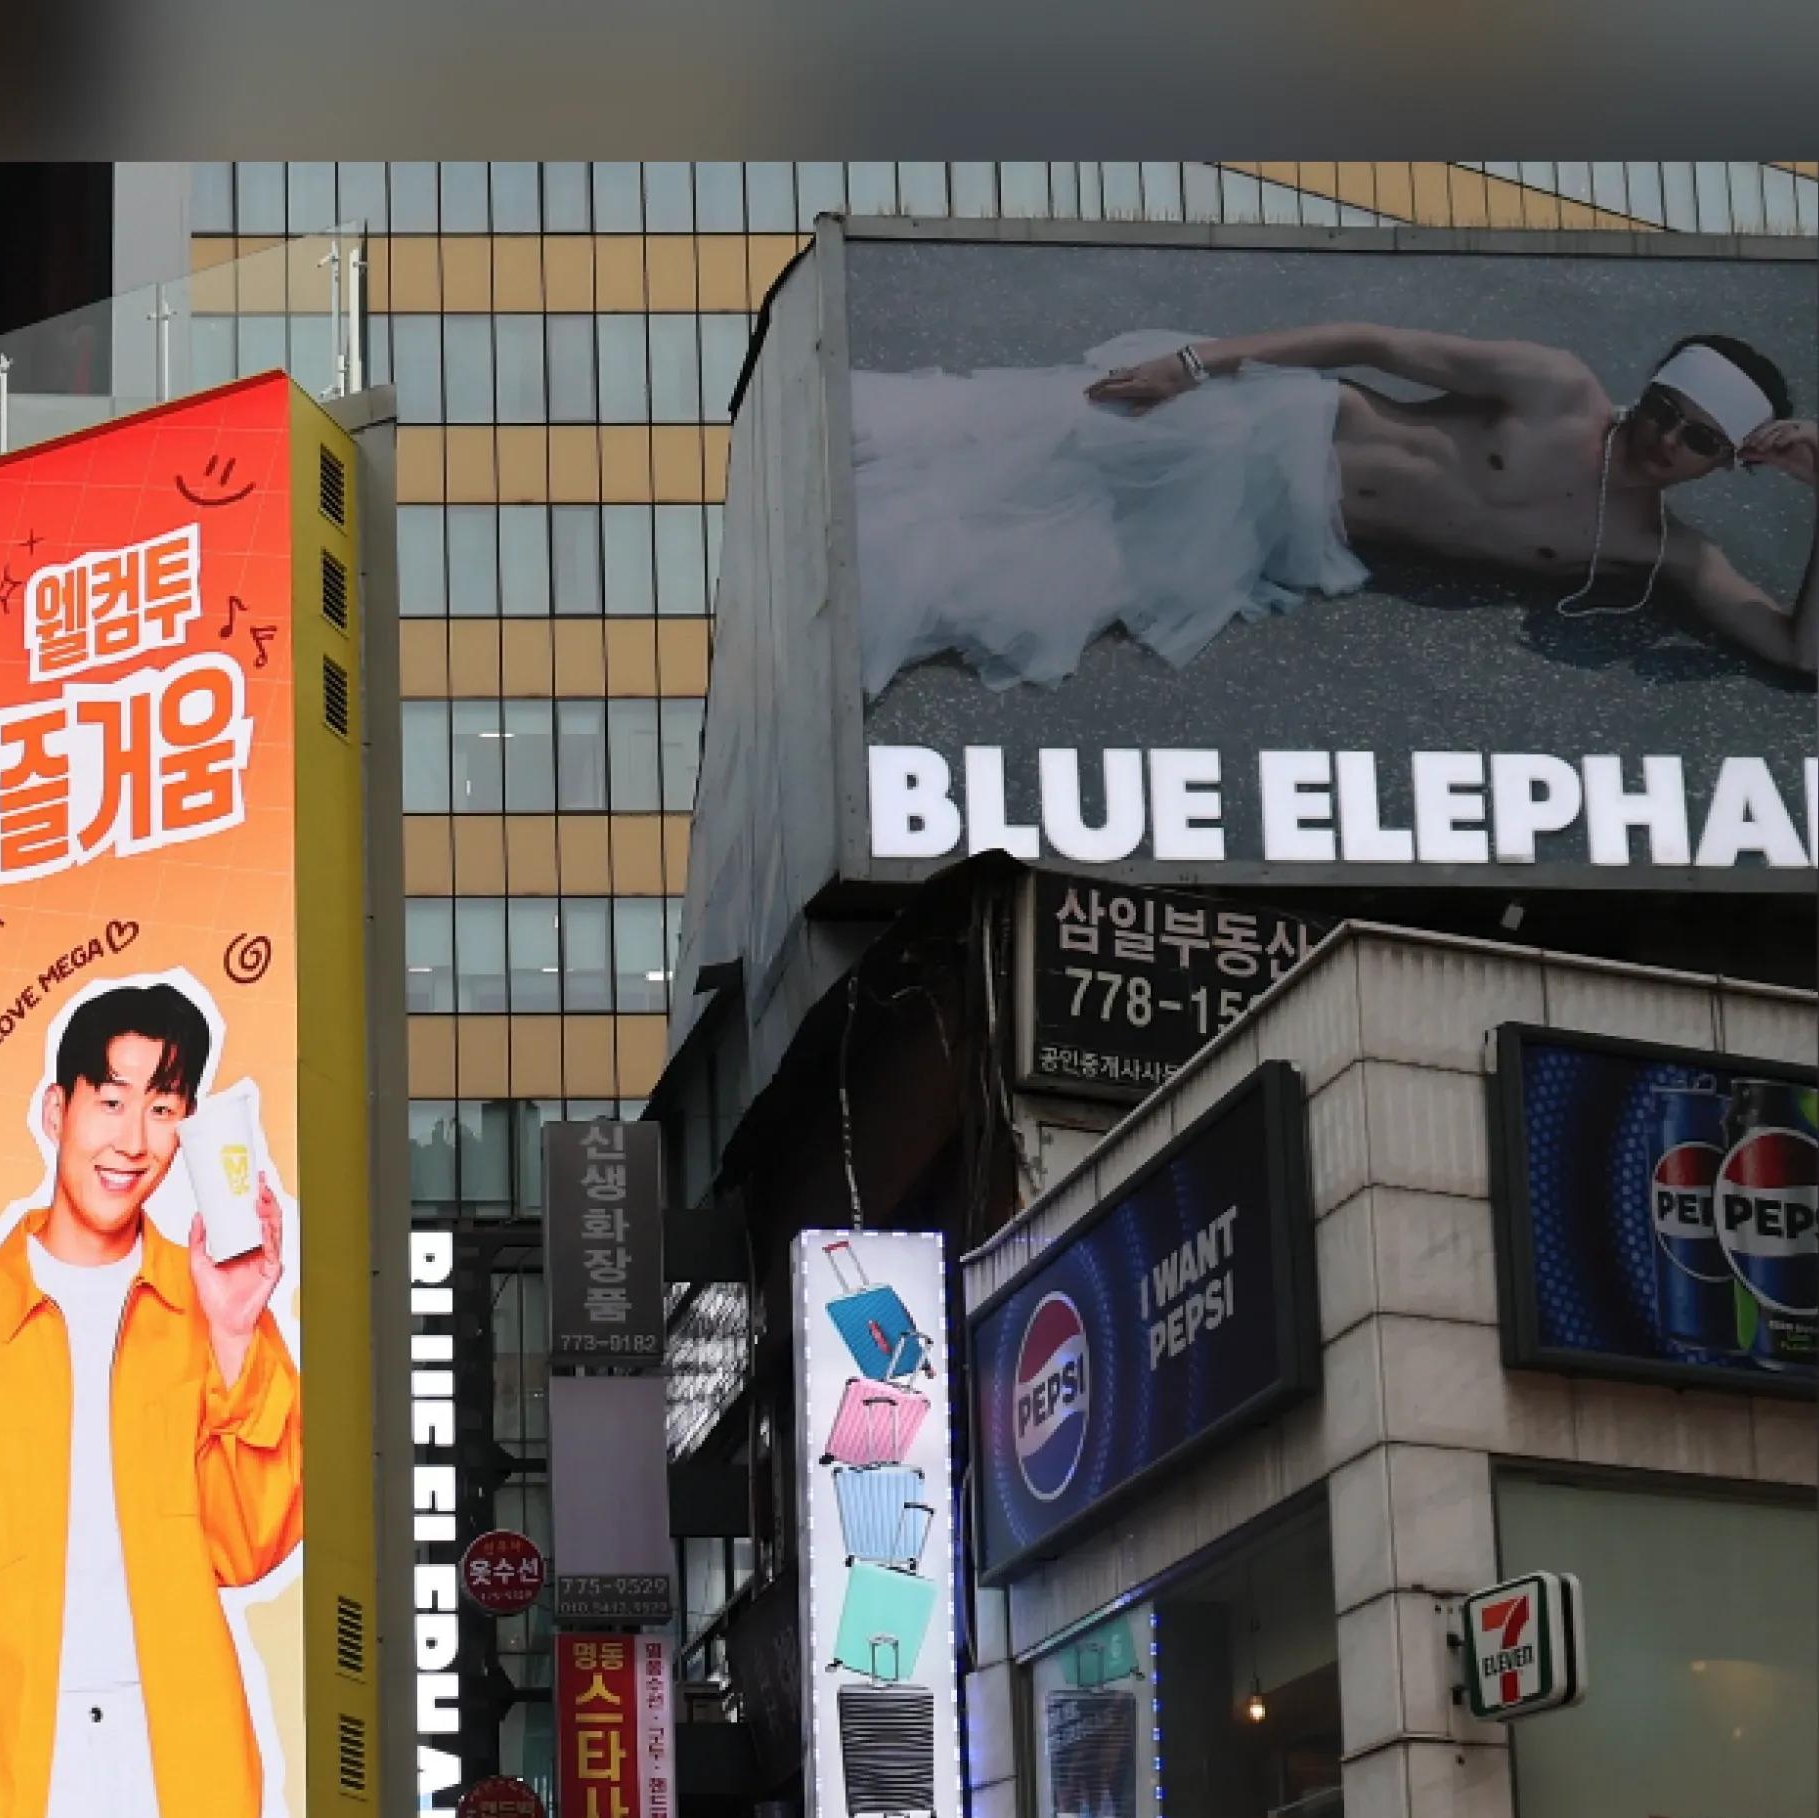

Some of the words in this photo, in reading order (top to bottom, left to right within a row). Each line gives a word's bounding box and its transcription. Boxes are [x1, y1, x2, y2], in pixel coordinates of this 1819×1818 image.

[28, 528, 198, 678] 웰컴투
[869, 744, 1225, 862] BLUE
[1258, 748, 1819, 867] ELEPHA
[37, 938, 104, 993] MEGA
[1055, 887, 1312, 982] 삼일부동산
[1063, 966, 1262, 1035] 778-15
[579, 1123, 632, 1323] 신생화장품
[1152, 1206, 1238, 1312] WANT
[1723, 1193, 1819, 1239] PEP
[1149, 1289, 1237, 1374] PEPSI
[1017, 1359, 1087, 1439] PEPSI
[573, 1642, 624, 1670] 명동
[1482, 1594, 1531, 1703] 7
